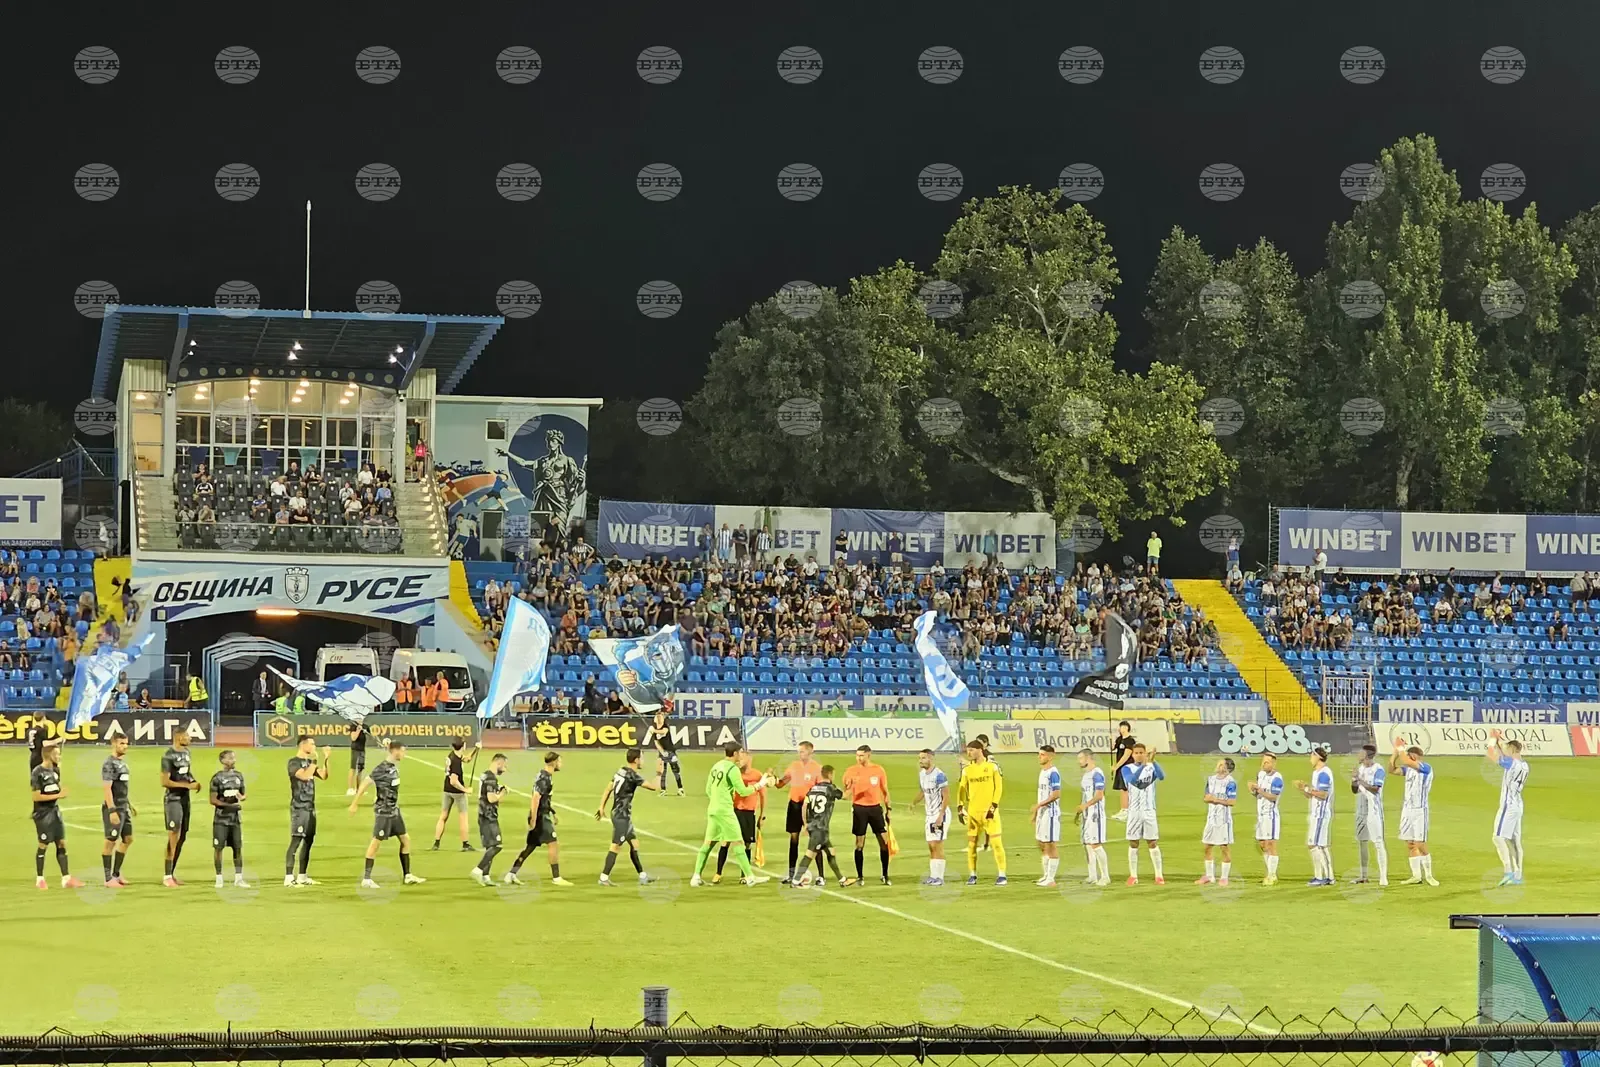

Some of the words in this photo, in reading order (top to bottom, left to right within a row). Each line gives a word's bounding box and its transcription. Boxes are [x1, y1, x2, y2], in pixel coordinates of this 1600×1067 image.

[1288, 527, 1392, 551] WINBET
[1412, 531, 1516, 554] WINBET
[153, 576, 274, 603] ОБЩИНА
[316, 574, 432, 605] РУСЕ
[1388, 708, 1464, 723] WINBET
[1481, 708, 1559, 724] WINBET
[104, 718, 206, 740] ЛИГА
[297, 724, 352, 736] БЪЛГАРС
[369, 724, 433, 737] ФУТБОЛЕН
[436, 724, 472, 737] СЪЮЗ
[535, 721, 638, 745] efbet
[810, 727, 880, 741] ОБЩИНА
[885, 727, 924, 740] РУСЕ
[1442, 728, 1487, 741] KINO
